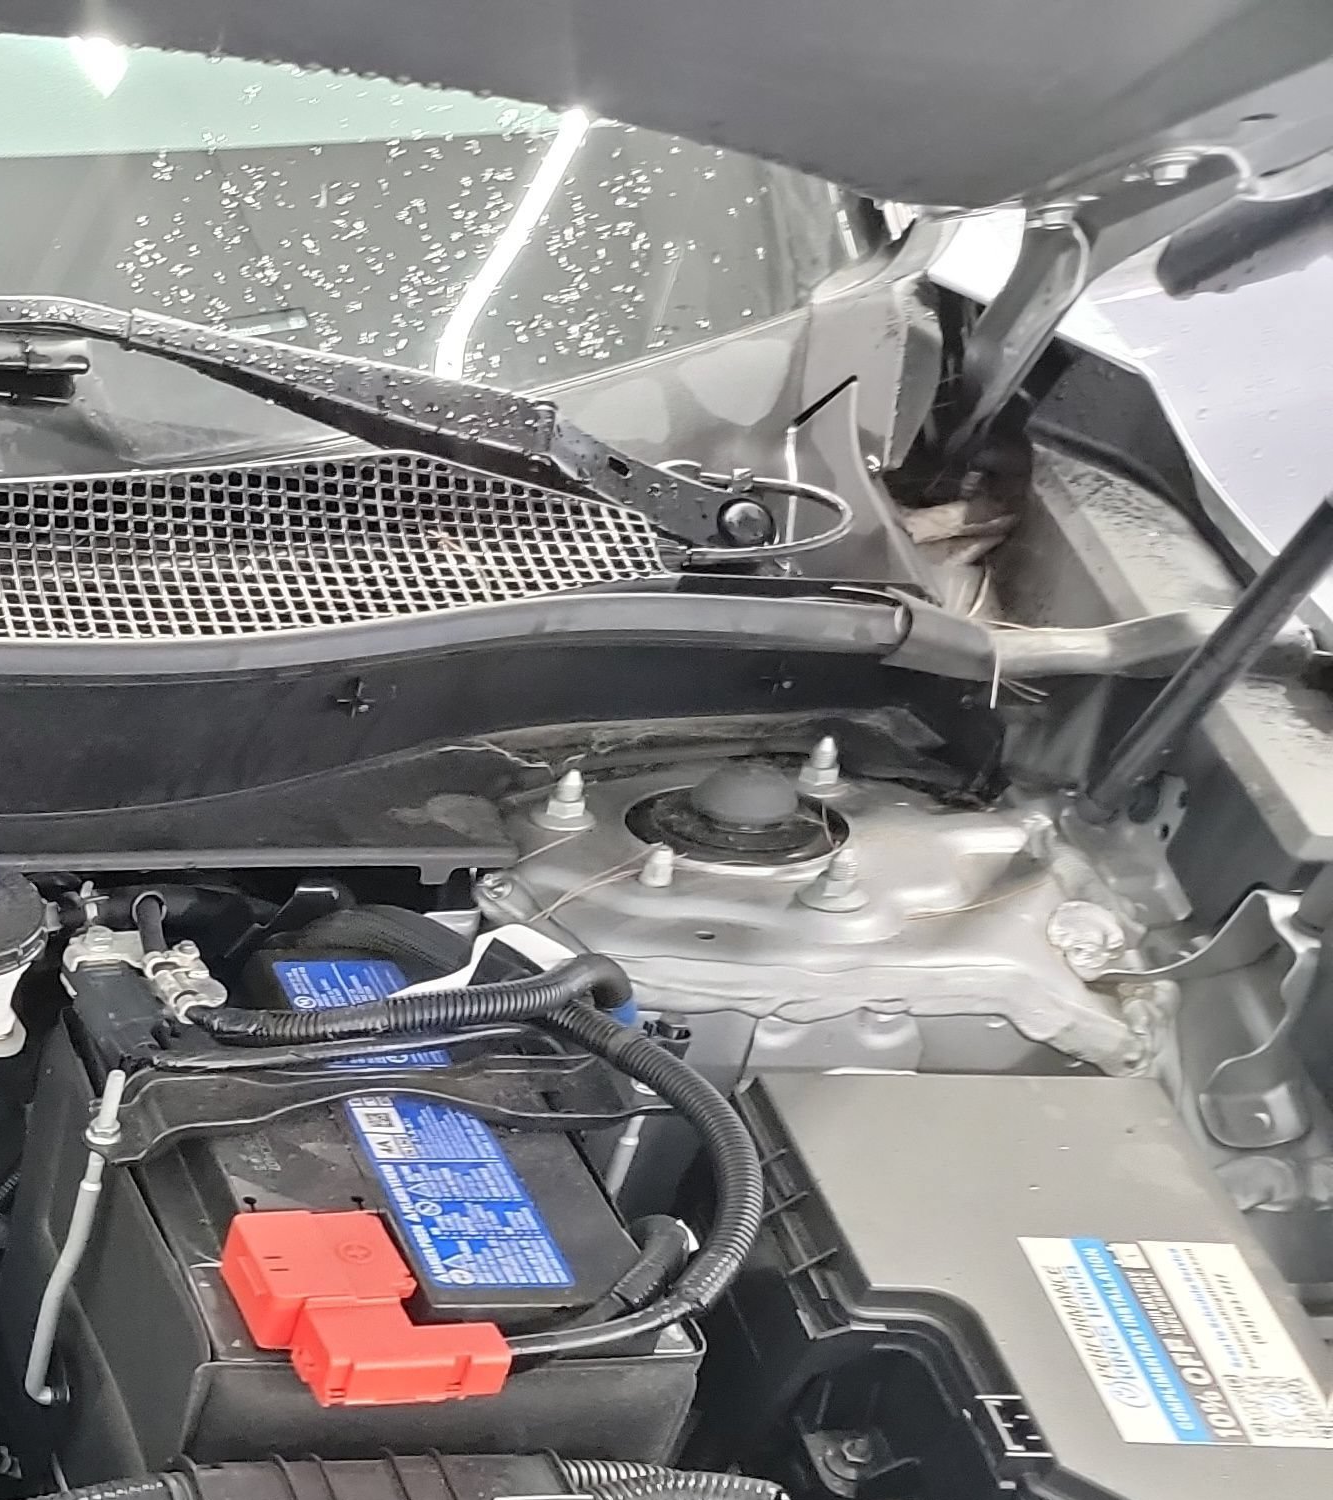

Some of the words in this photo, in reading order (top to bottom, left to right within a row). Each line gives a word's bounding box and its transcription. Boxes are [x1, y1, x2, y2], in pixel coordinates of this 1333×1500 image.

[1040, 1265, 1111, 1379] PERFORMANCE
[1082, 1247, 1138, 1327] INSTALLATION
[1125, 1328, 1195, 1430] COMPLIMENTARY
[1162, 1338, 1213, 1385] OFF
[1196, 1389, 1243, 1437] 10%
